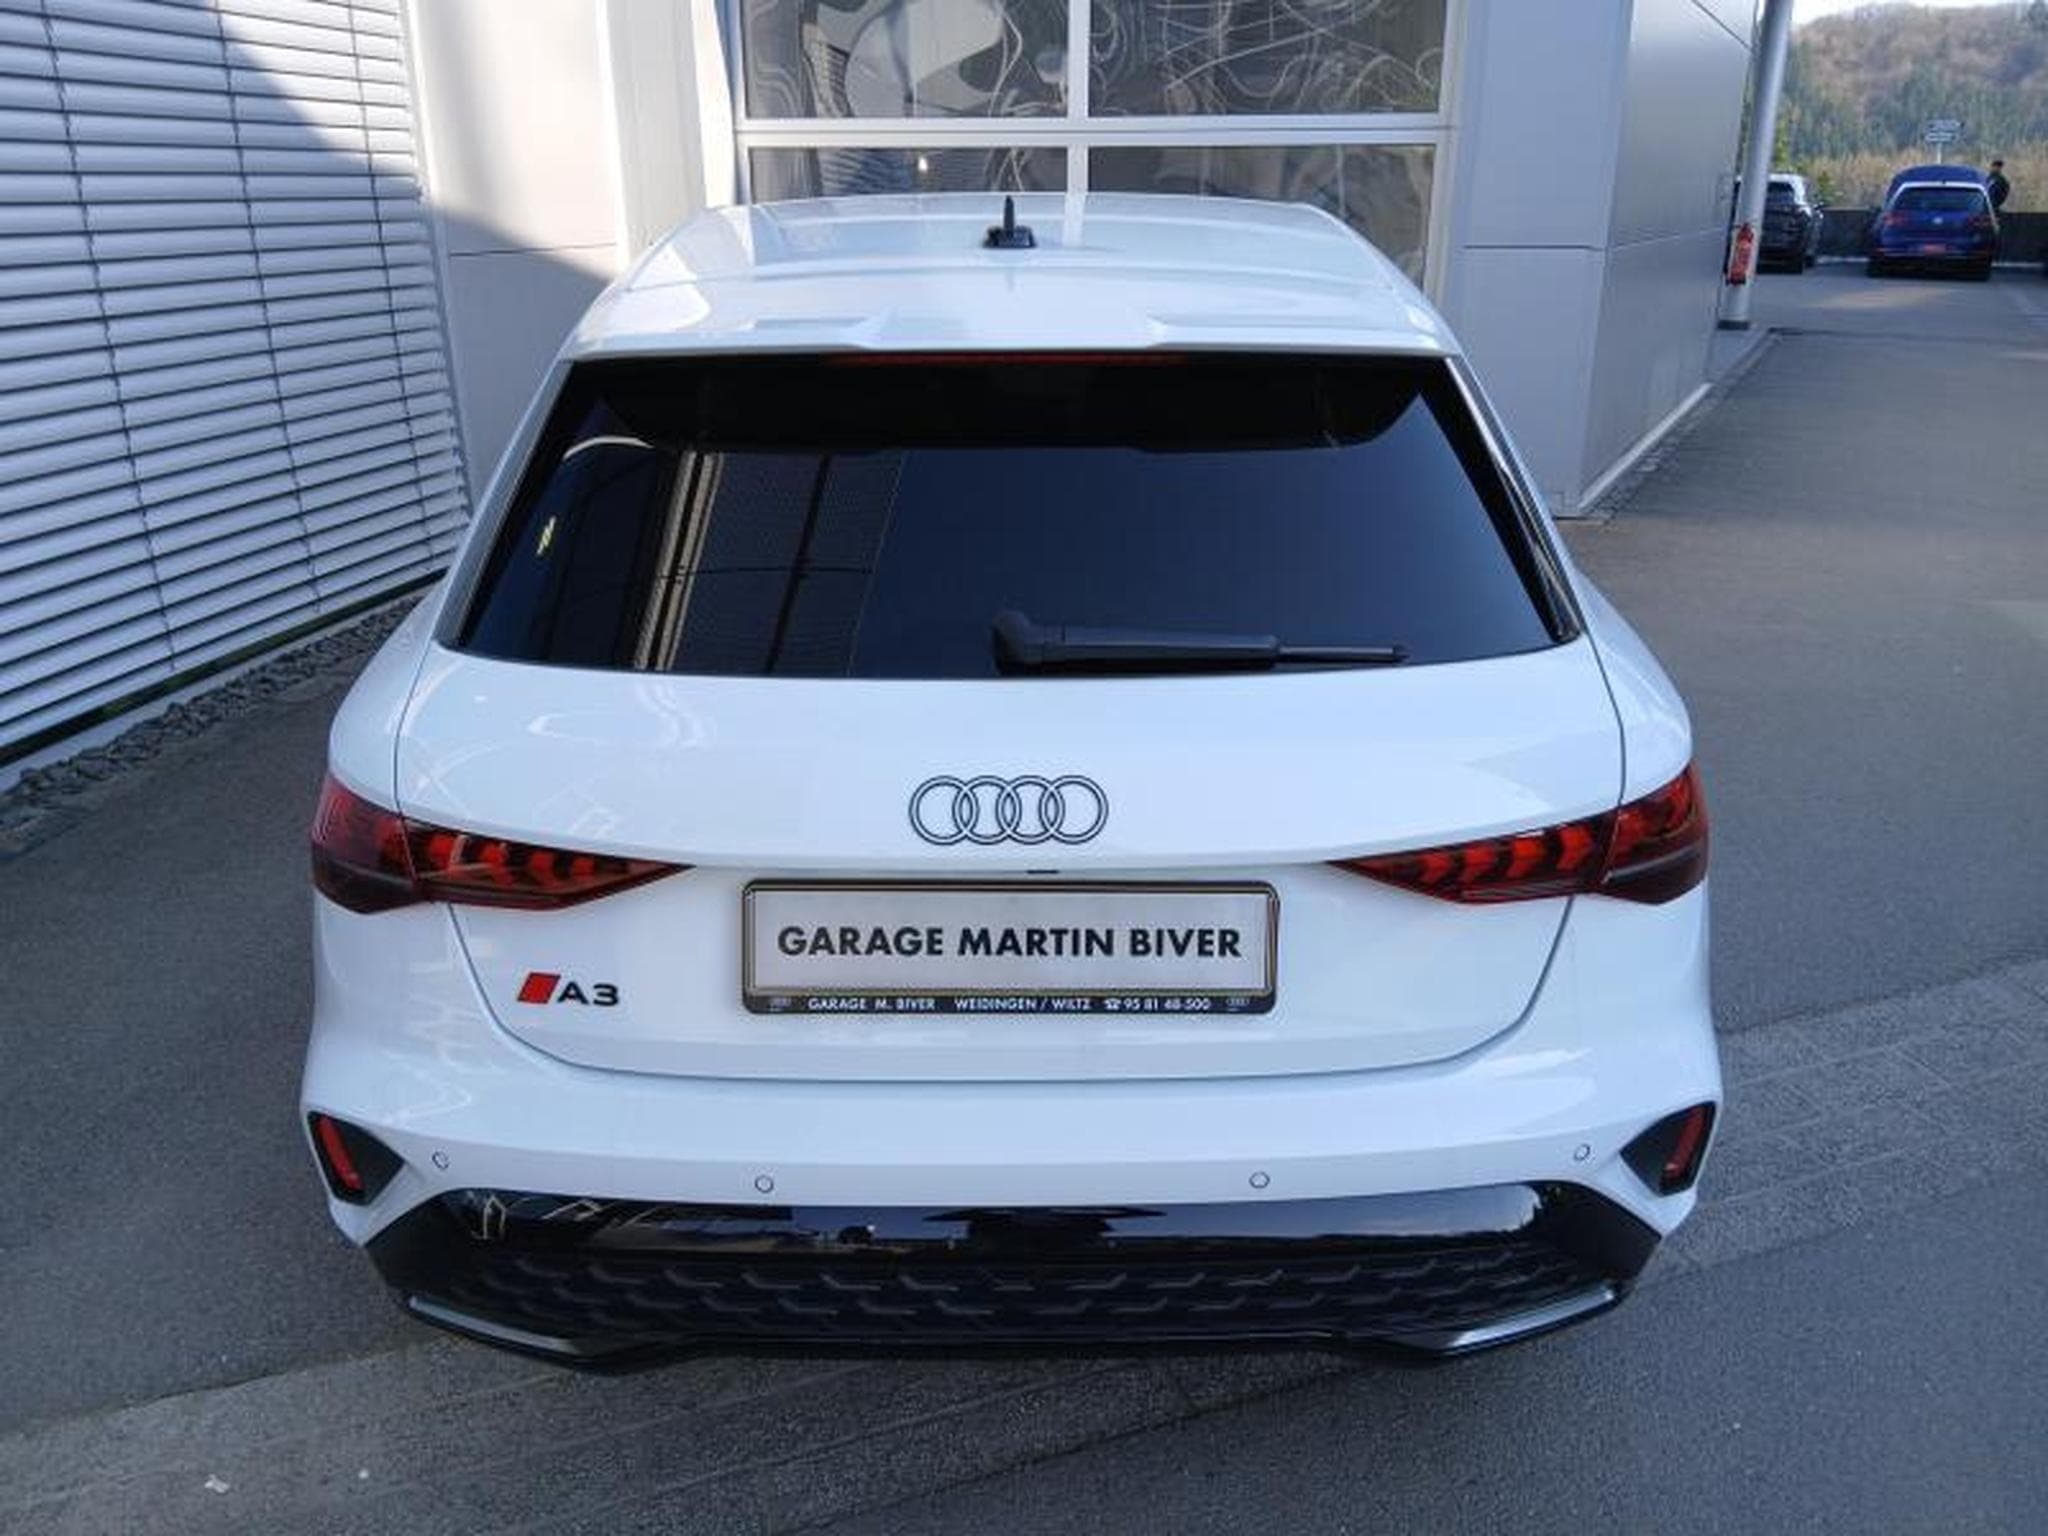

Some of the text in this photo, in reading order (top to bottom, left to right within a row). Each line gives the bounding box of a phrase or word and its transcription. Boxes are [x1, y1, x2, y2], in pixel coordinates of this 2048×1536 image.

[777, 926, 1242, 958] GARAGE MARTIN BIVER
[557, 981, 620, 1007] A3
[808, 998, 866, 1010] GARAGE
[896, 998, 935, 1010] BIVER
